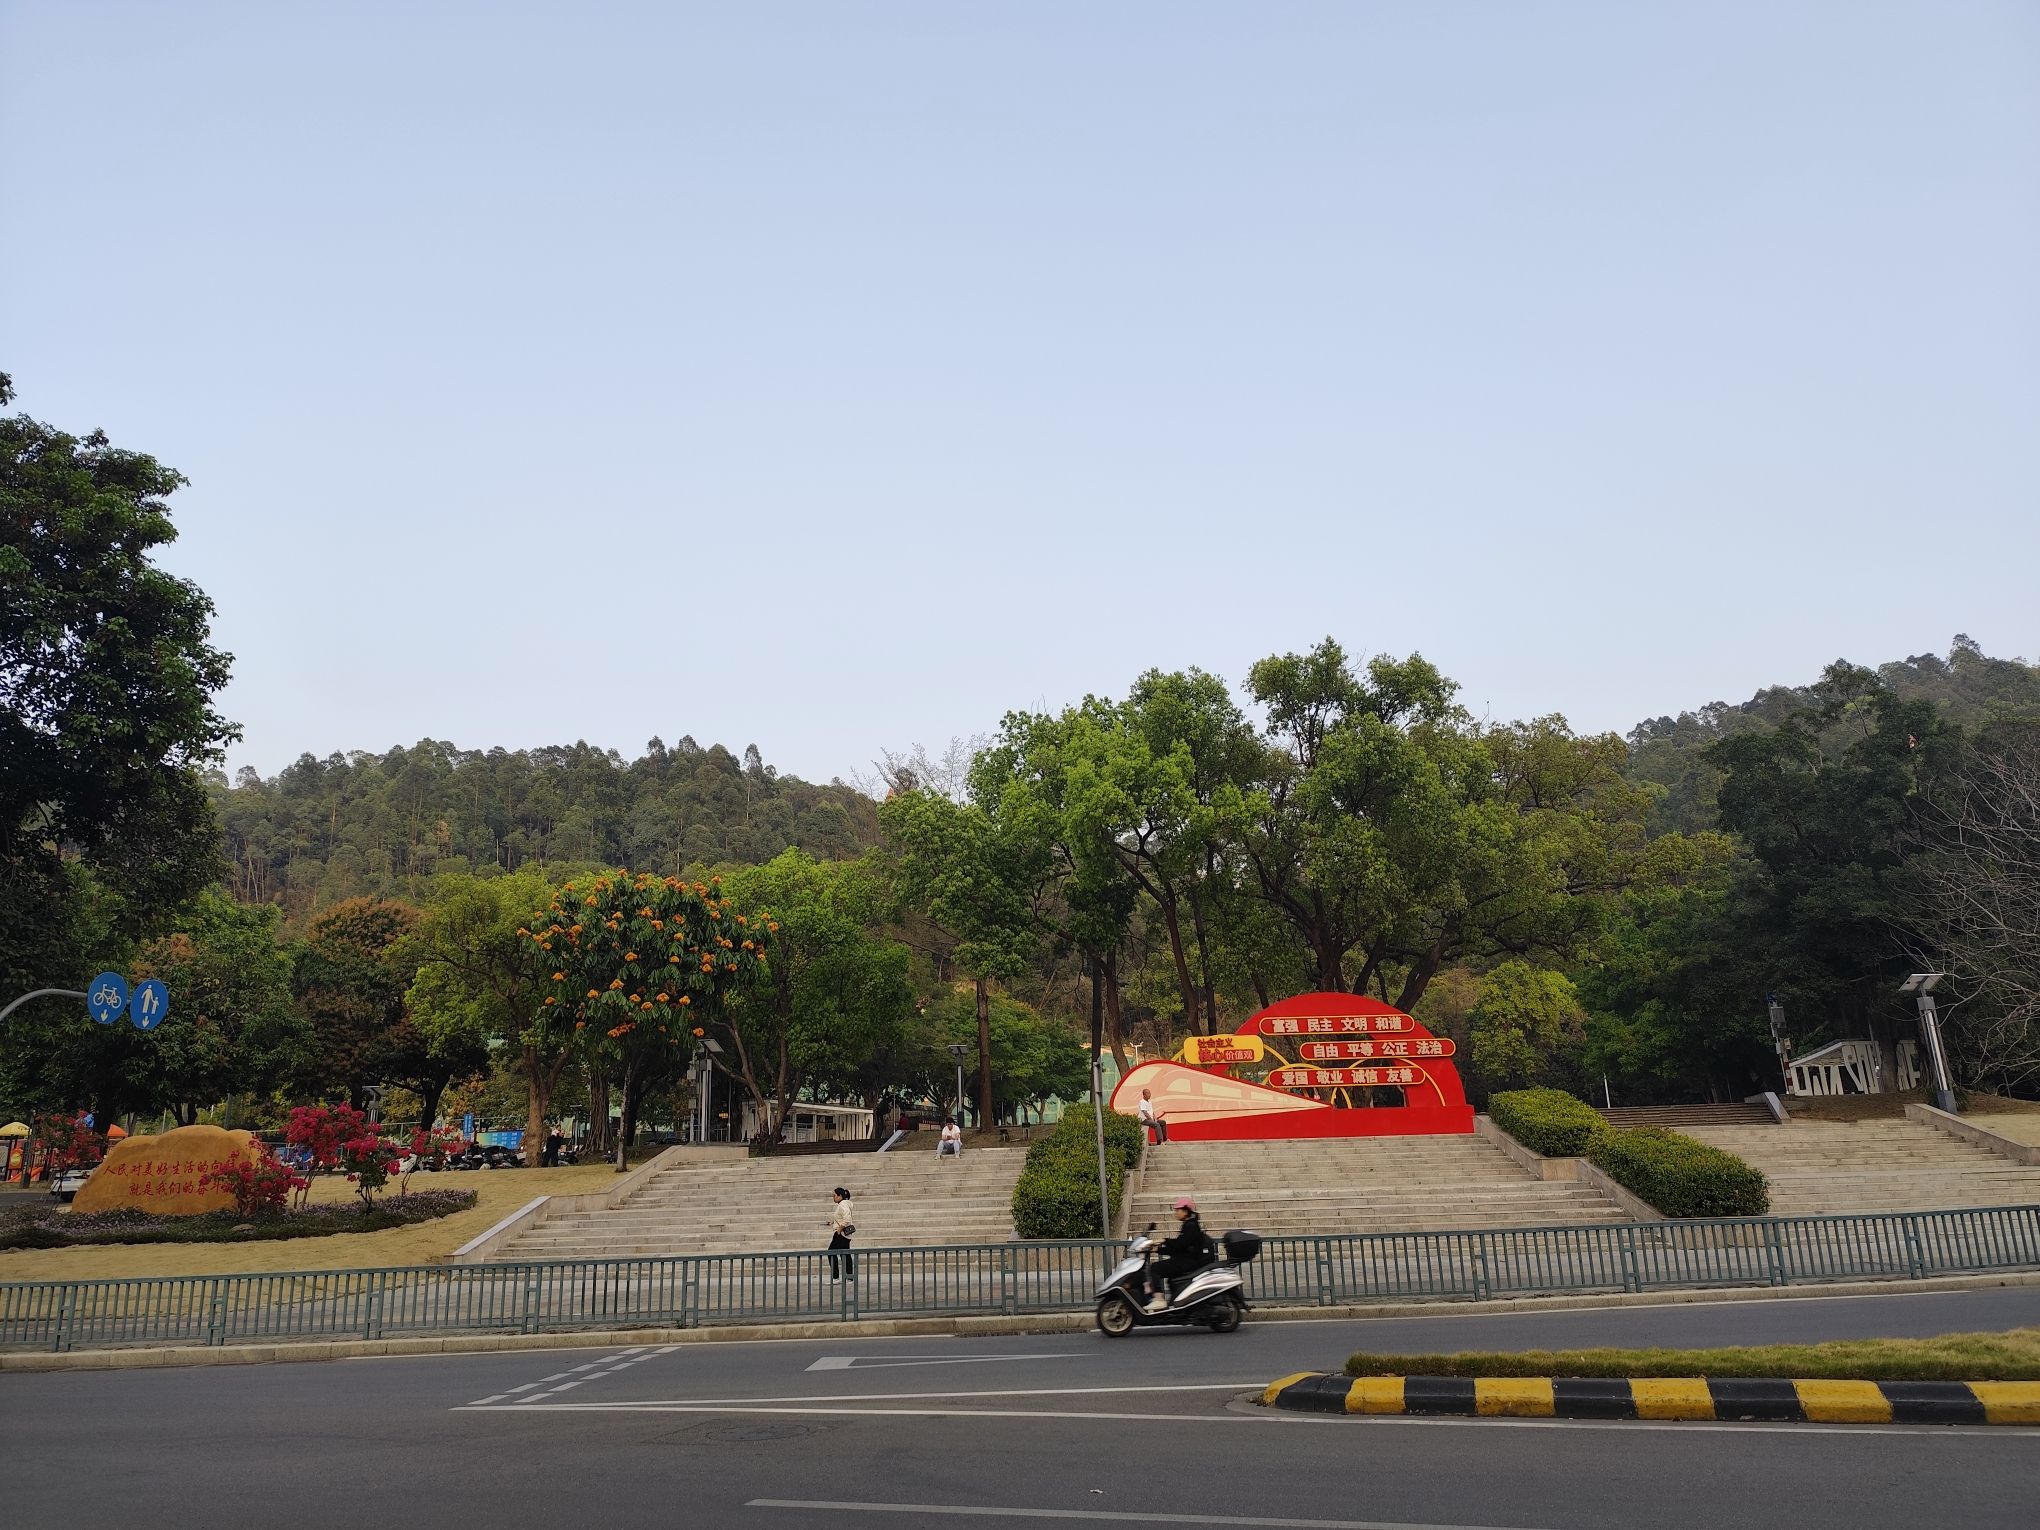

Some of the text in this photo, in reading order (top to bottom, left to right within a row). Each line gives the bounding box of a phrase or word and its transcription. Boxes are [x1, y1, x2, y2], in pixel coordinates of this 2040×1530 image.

[1272, 1016, 1402, 1033] 富强 民主 文明 和谐
[1197, 1037, 1234, 1048] 社会主义
[1313, 1040, 1443, 1058] 自由 平等 公正 法治
[1198, 1048, 1254, 1062] 核心价值观
[1281, 1068, 1413, 1085] 爱国 敬业 诚信 友善
[128, 1180, 232, 1197] 就是我们的奋斗
